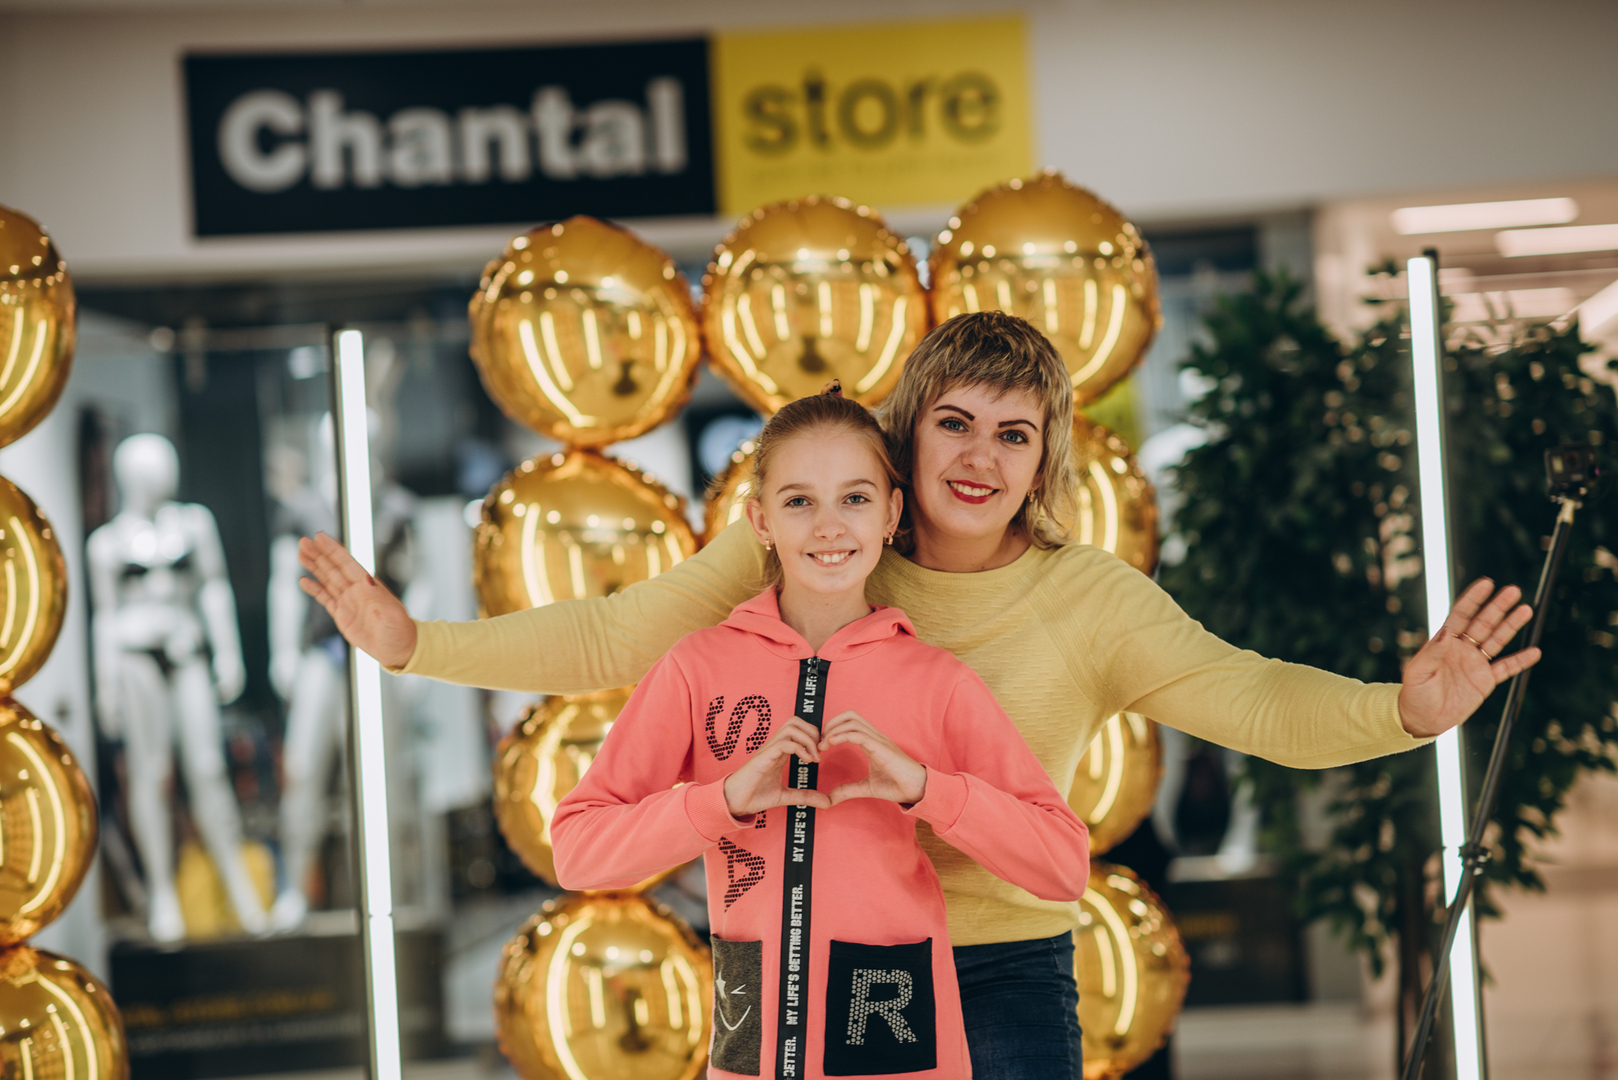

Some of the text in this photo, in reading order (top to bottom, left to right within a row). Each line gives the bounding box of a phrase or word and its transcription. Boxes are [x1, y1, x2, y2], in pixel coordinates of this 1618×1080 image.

[216, 66, 1003, 194] Chantal store
[803, 698, 815, 713] MY
[796, 766, 809, 809] GTING
[794, 811, 807, 844] LIFE'S
[792, 846, 805, 862] MY
[785, 884, 803, 1025] MY LIFE'S GETTING BETTER.
[845, 968, 919, 1046] R
